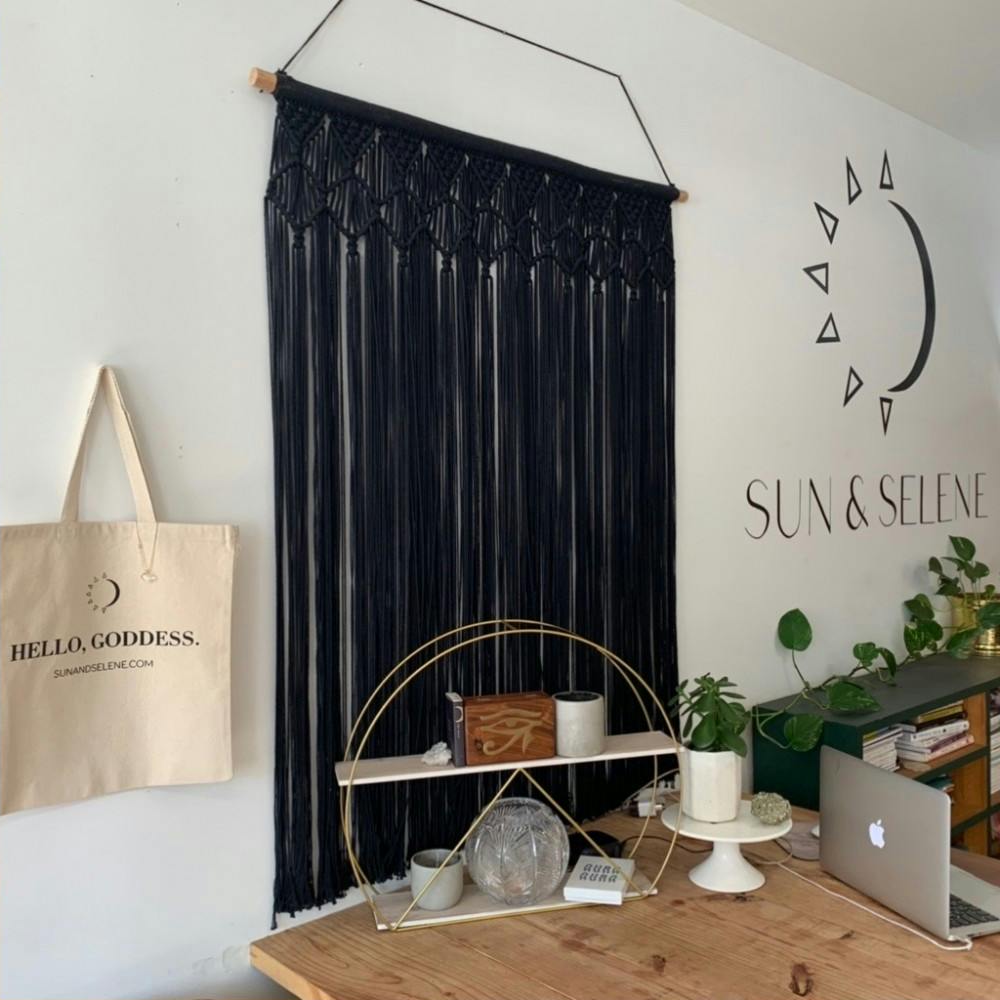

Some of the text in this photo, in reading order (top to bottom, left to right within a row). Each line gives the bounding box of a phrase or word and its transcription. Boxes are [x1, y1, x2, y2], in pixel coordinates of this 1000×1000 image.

[745, 472, 989, 539] SUN & SELENE
[10, 631, 200, 662] HELLO, GODDESS.
[54, 659, 154, 679] SUNANDSELENE.COM
